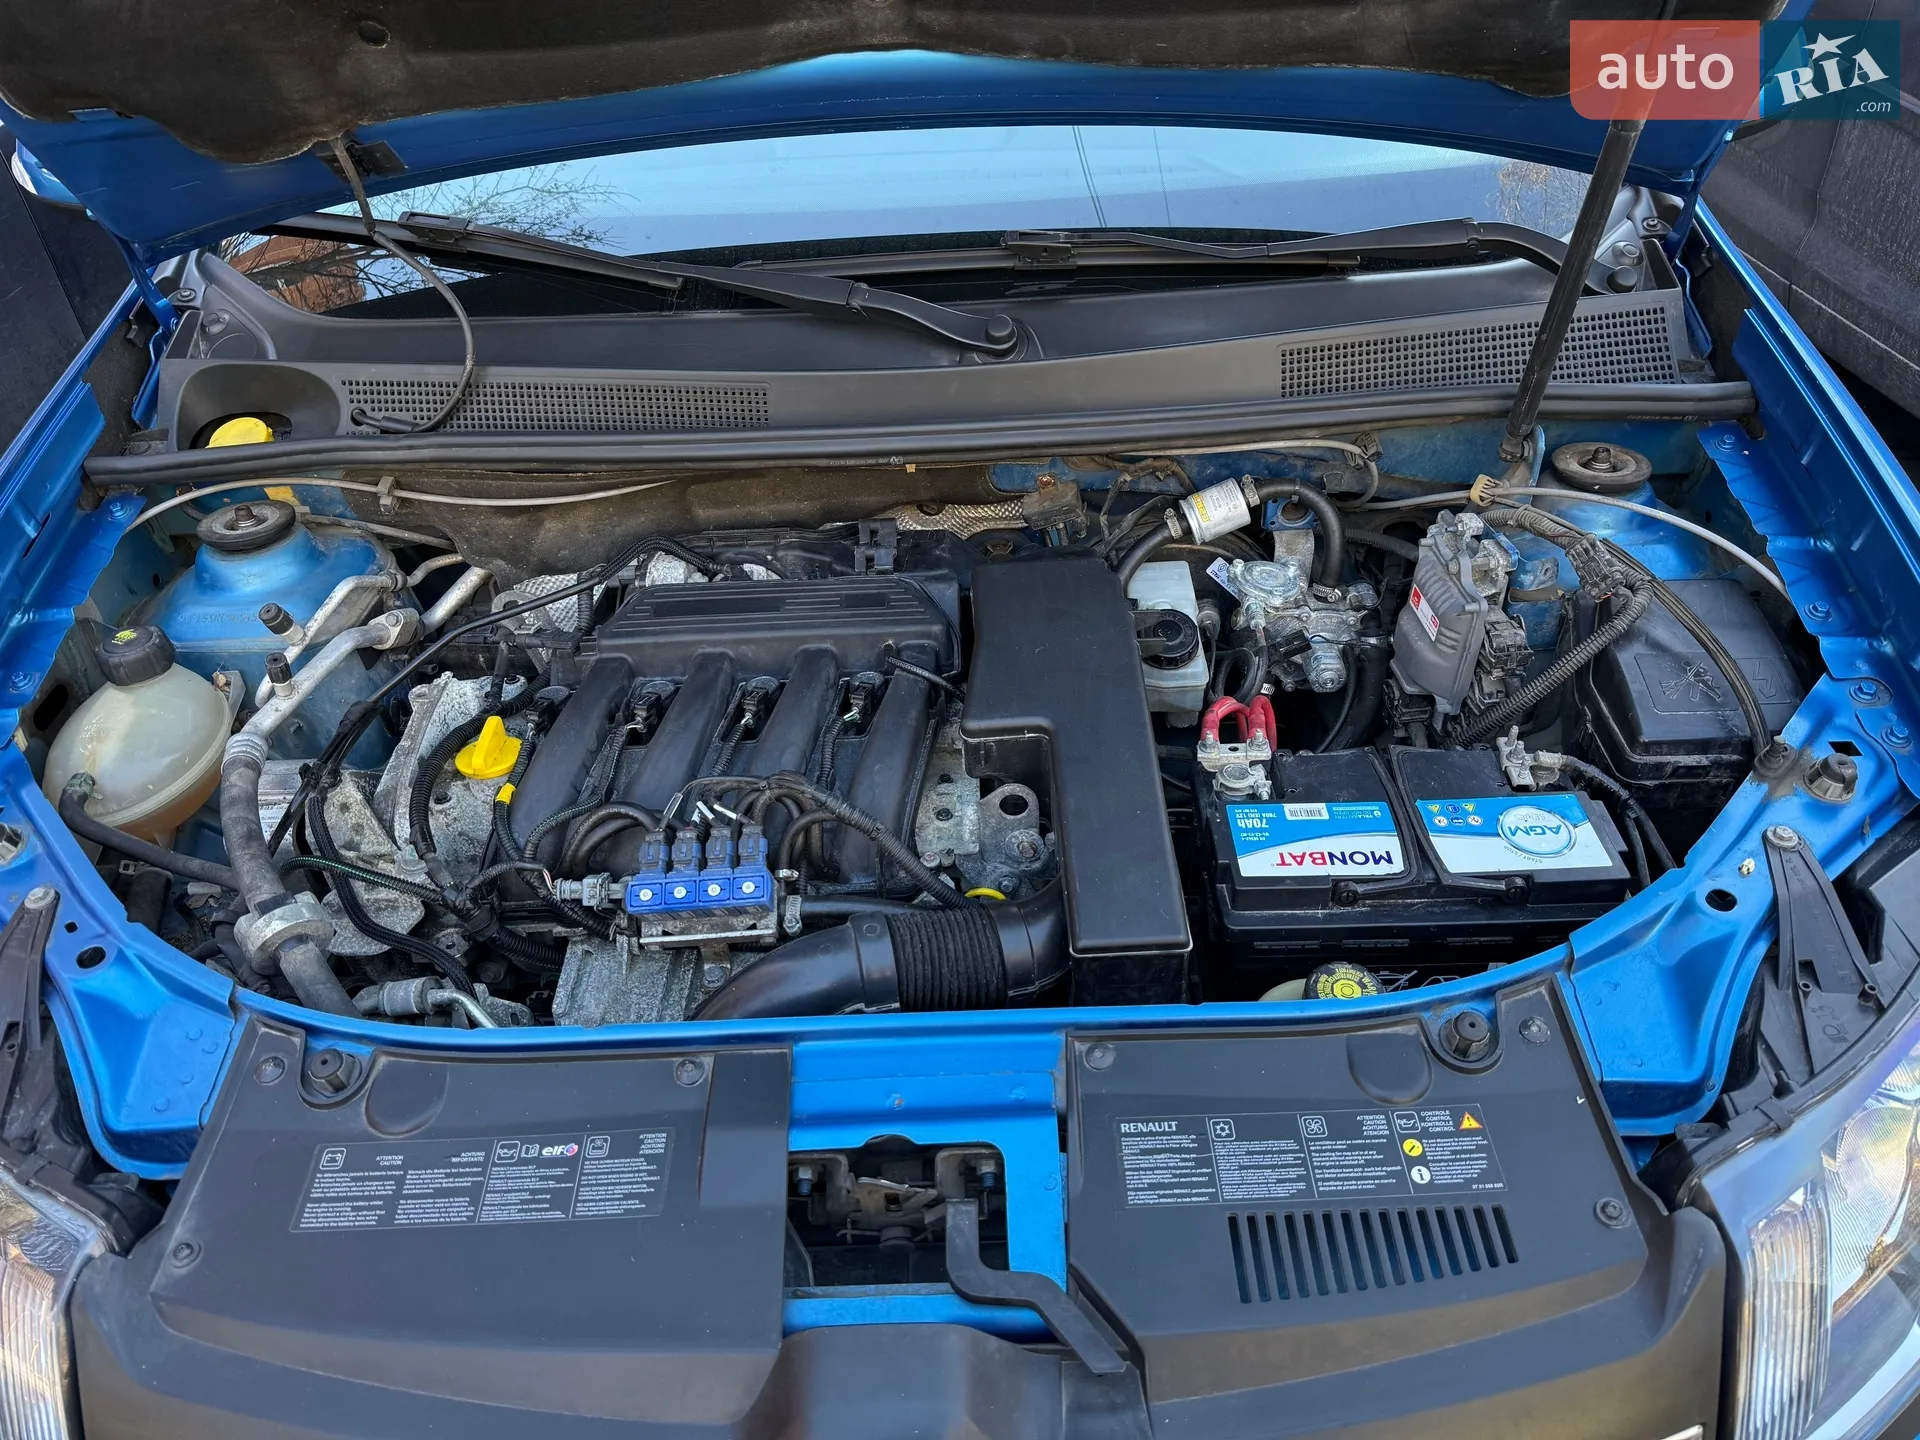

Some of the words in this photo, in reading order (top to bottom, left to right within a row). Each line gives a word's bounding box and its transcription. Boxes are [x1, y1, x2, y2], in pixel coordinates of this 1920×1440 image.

[1236, 817, 1269, 828] 70Ah
[1507, 824, 1562, 836] AGM
[1276, 851, 1394, 866] MONBAT
[1120, 1121, 1179, 1133] RENAULT
[540, 1144, 565, 1156] elf
